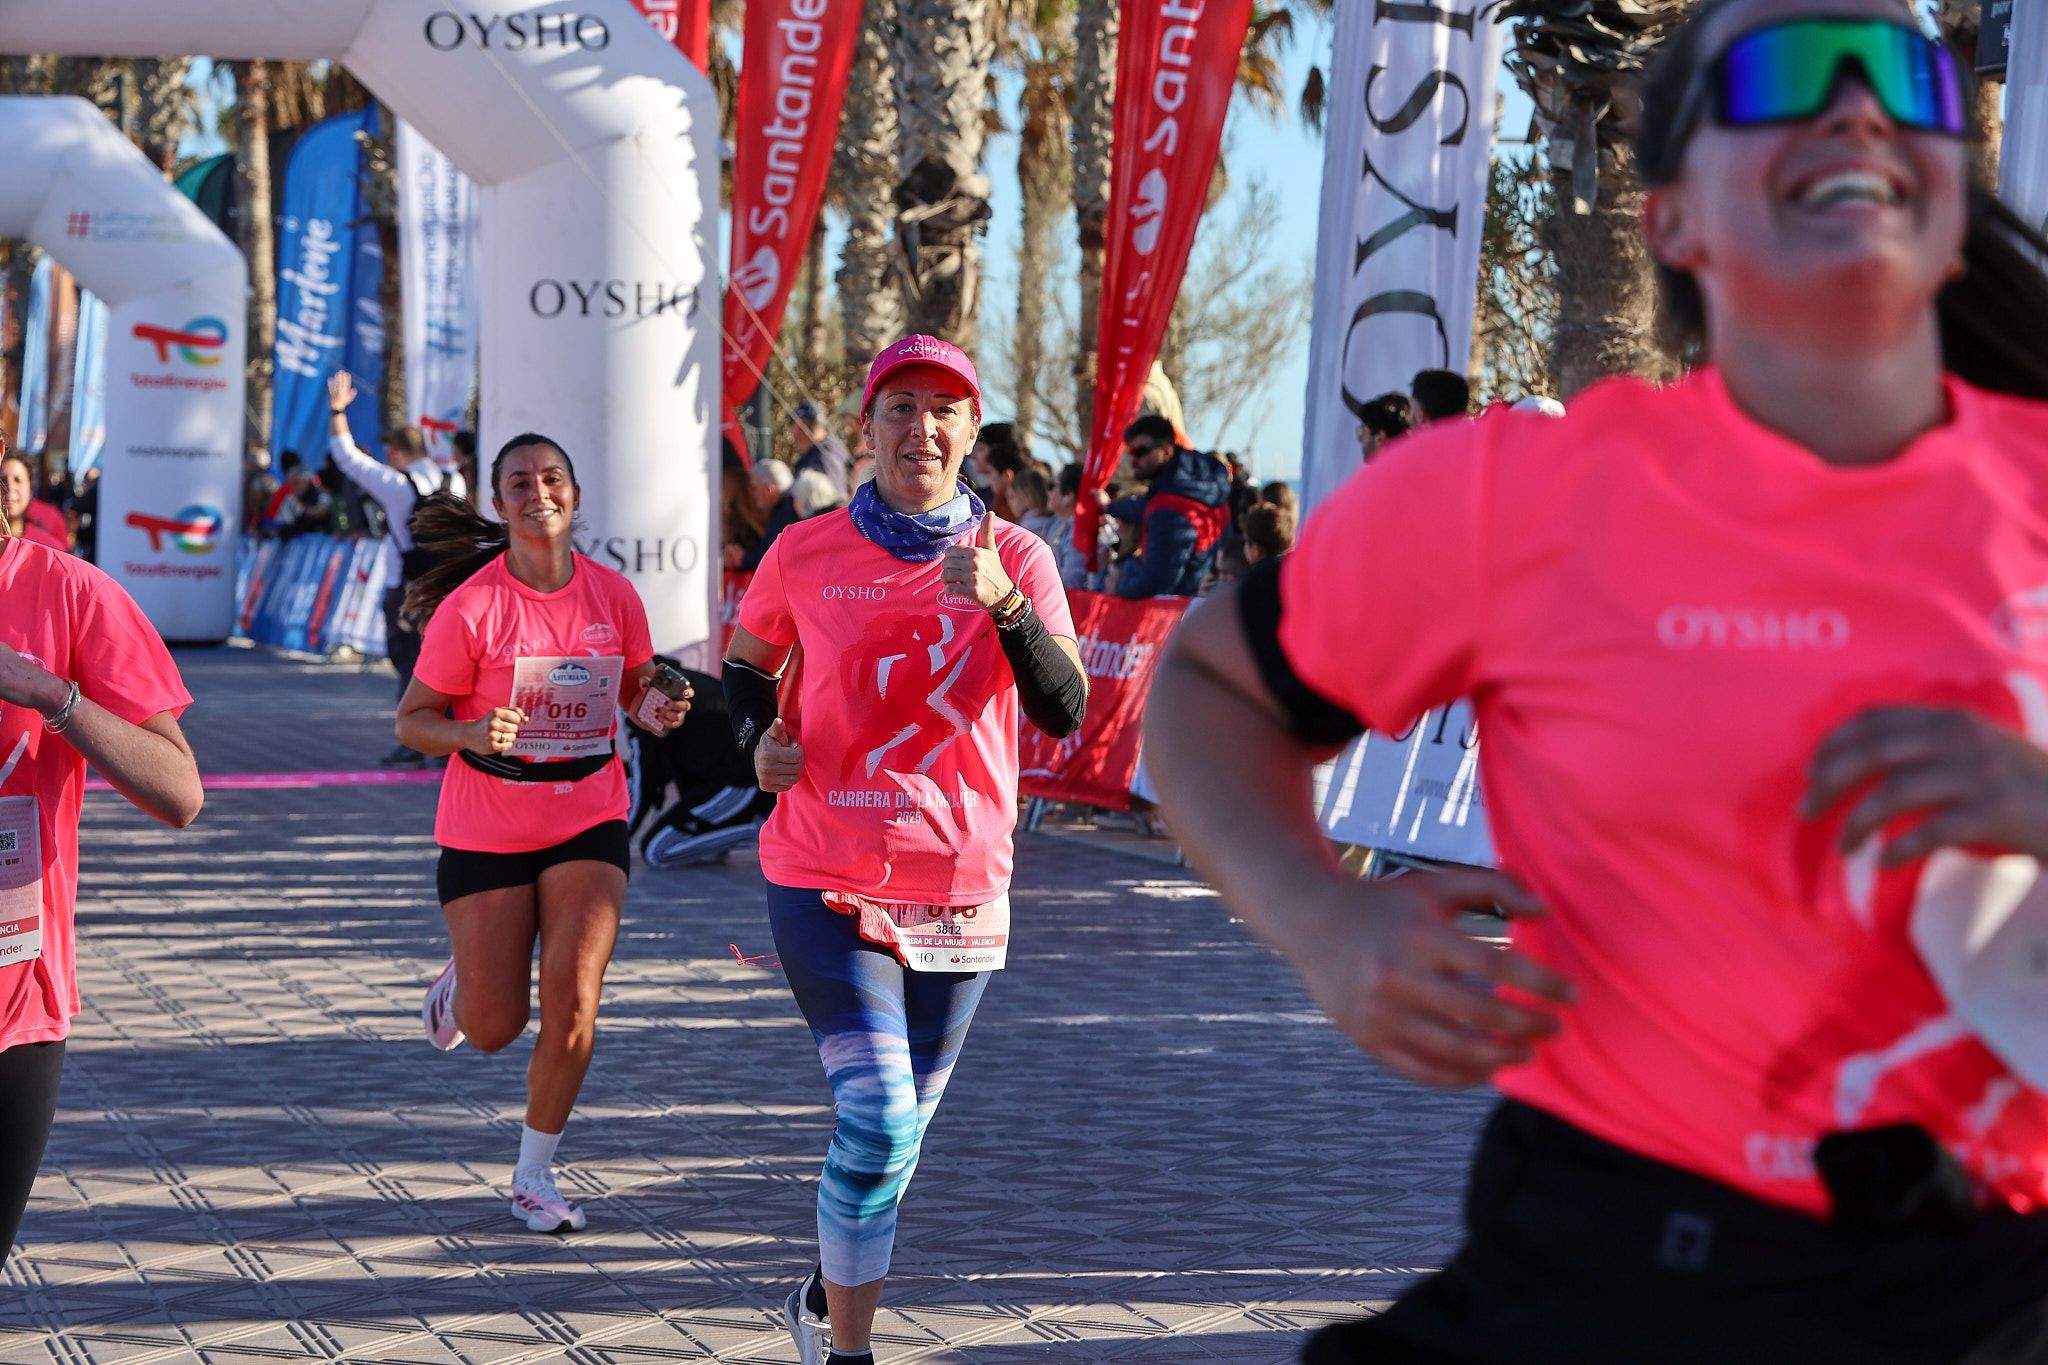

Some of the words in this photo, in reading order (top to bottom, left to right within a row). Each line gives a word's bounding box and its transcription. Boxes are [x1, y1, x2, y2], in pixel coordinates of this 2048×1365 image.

[424, 10, 611, 51] OYSHO
[748, 0, 828, 240] Santande
[529, 278, 700, 319] OYSHO
[822, 585, 886, 601] OYSHO
[1655, 602, 1851, 652] OYSHO
[547, 702, 588, 719] 016
[515, 742, 551, 751] OYSHO
[828, 789, 891, 808] CARRERA
[895, 791, 912, 808] DE
[917, 791, 935, 808] LA
[896, 811, 923, 824] 2025
[935, 924, 961, 935] 3812
[0, 944, 23, 956] nder
[924, 938, 933, 946] DE
[935, 938, 943, 946] LA
[944, 938, 967, 947] MUJER
[961, 955, 996, 964] Santander
